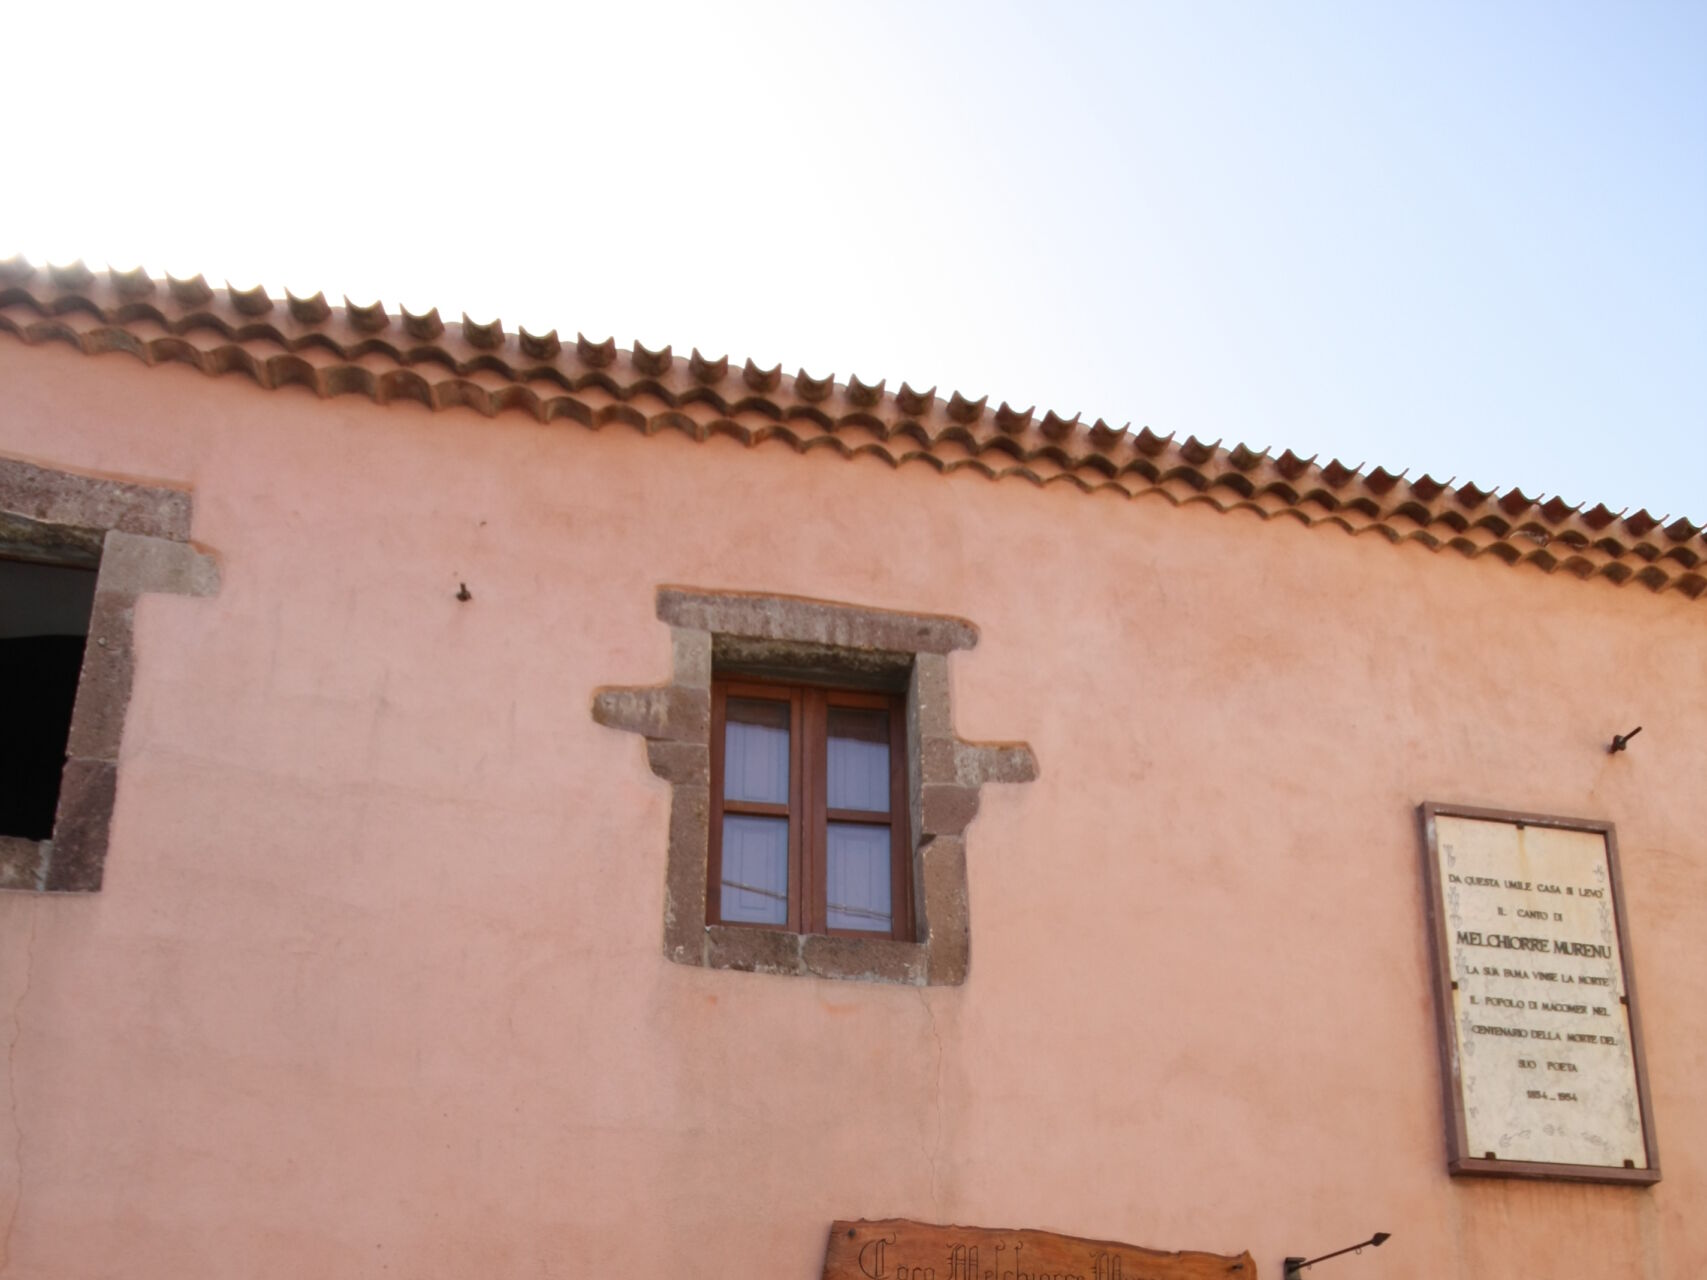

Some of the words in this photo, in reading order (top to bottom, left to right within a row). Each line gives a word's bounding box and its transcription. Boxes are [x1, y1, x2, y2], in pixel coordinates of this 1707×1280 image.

[1449, 874, 1463, 884] DA
[1464, 876, 1500, 888] QUESTA
[1504, 880, 1531, 891] UMILE
[1537, 883, 1561, 894] CASA
[1497, 907, 1507, 916] IL
[1517, 909, 1548, 921] CANTO
[1554, 912, 1563, 922] DI
[1457, 931, 1550, 953] MELCHIORRE
[1553, 940, 1611, 959] MURENU
[1465, 965, 1480, 975] LA
[1483, 967, 1499, 977] SUA
[1503, 968, 1529, 980] FAMA
[1532, 971, 1558, 982] VINSE
[1561, 974, 1574, 984] LA
[1578, 976, 1610, 987] MORTE
[1469, 995, 1479, 1005] IL
[1485, 996, 1525, 1009] POPOLO
[1528, 1001, 1538, 1010] DI
[1541, 1002, 1588, 1014] MACOMER
[1592, 1006, 1610, 1017] NEL
[1471, 1025, 1529, 1038] CENTENARIO
[1530, 1029, 1562, 1041] DELLA
[1566, 1033, 1598, 1044] MORTE
[1599, 1036, 1618, 1046] DEL
[1518, 1060, 1537, 1070] SUO
[1546, 1062, 1578, 1073] POETA
[857, 1232, 936, 1280] Coro
